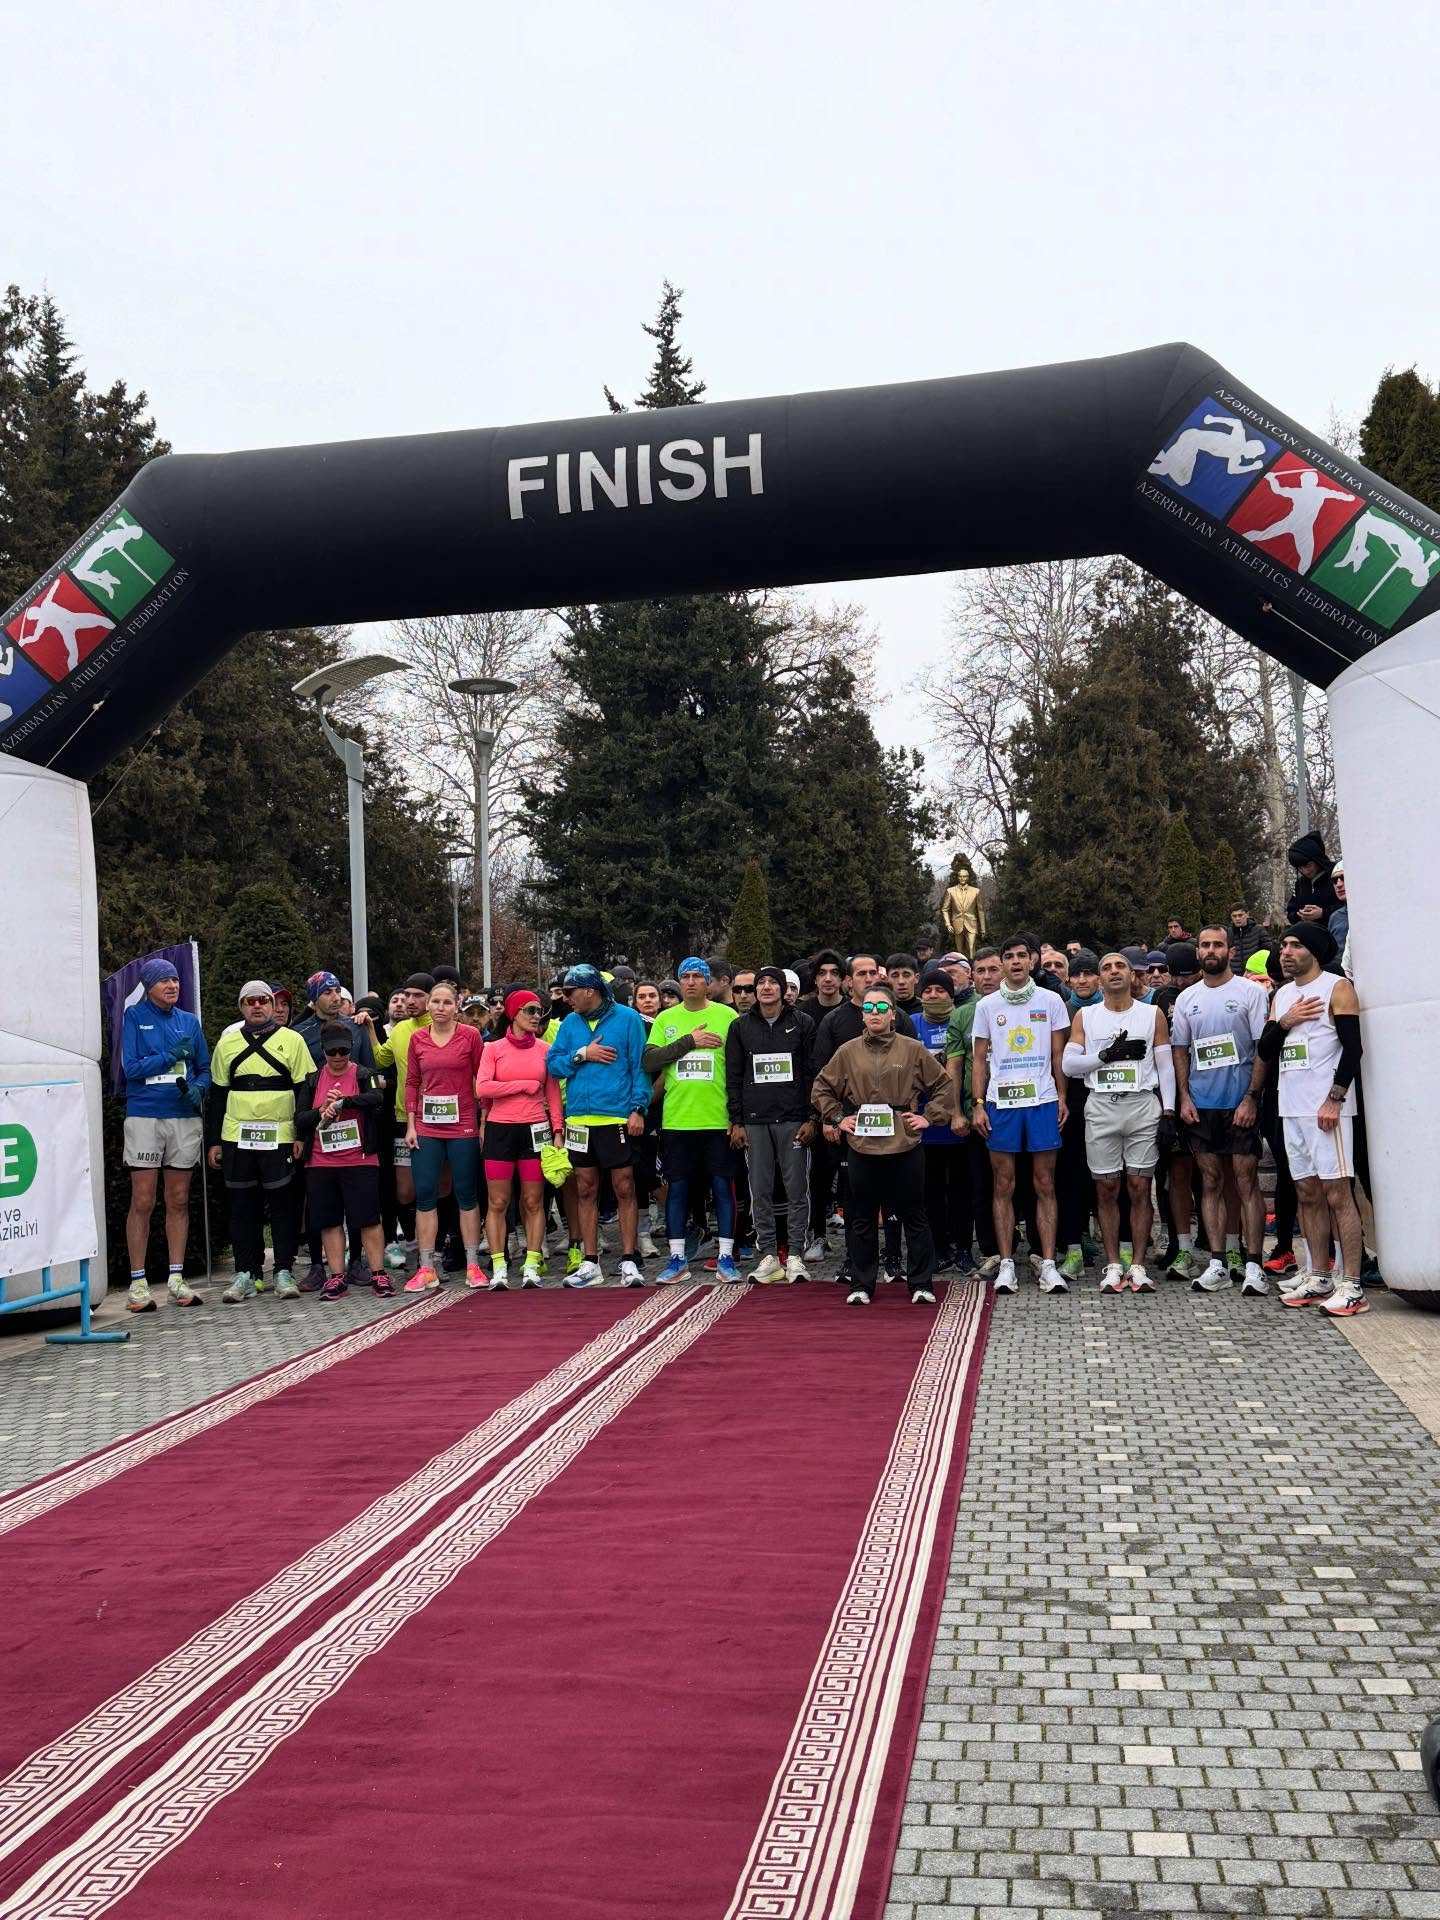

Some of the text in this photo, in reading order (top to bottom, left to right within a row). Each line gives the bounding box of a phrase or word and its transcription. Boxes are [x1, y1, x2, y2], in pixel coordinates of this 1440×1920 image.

[1215, 388, 1299, 446] AZƏRBAYCAN
[508, 433, 764, 520] FINISH
[1136, 481, 1382, 645] AZERBAIJAN ATHLETICS FEDERATION
[1, 568, 190, 752] AZERBAIJAN ATHLETICS FEDERATION
[1206, 1046, 1224, 1058] 052
[686, 1062, 703, 1070] 011
[764, 1063, 781, 1072] 010
[1106, 1071, 1125, 1081] 090
[1007, 1088, 1025, 1097] 073
[432, 1106, 448, 1114] 029
[864, 1115, 881, 1125] 071
[250, 1131, 266, 1140] 021
[331, 1131, 348, 1141] 086
